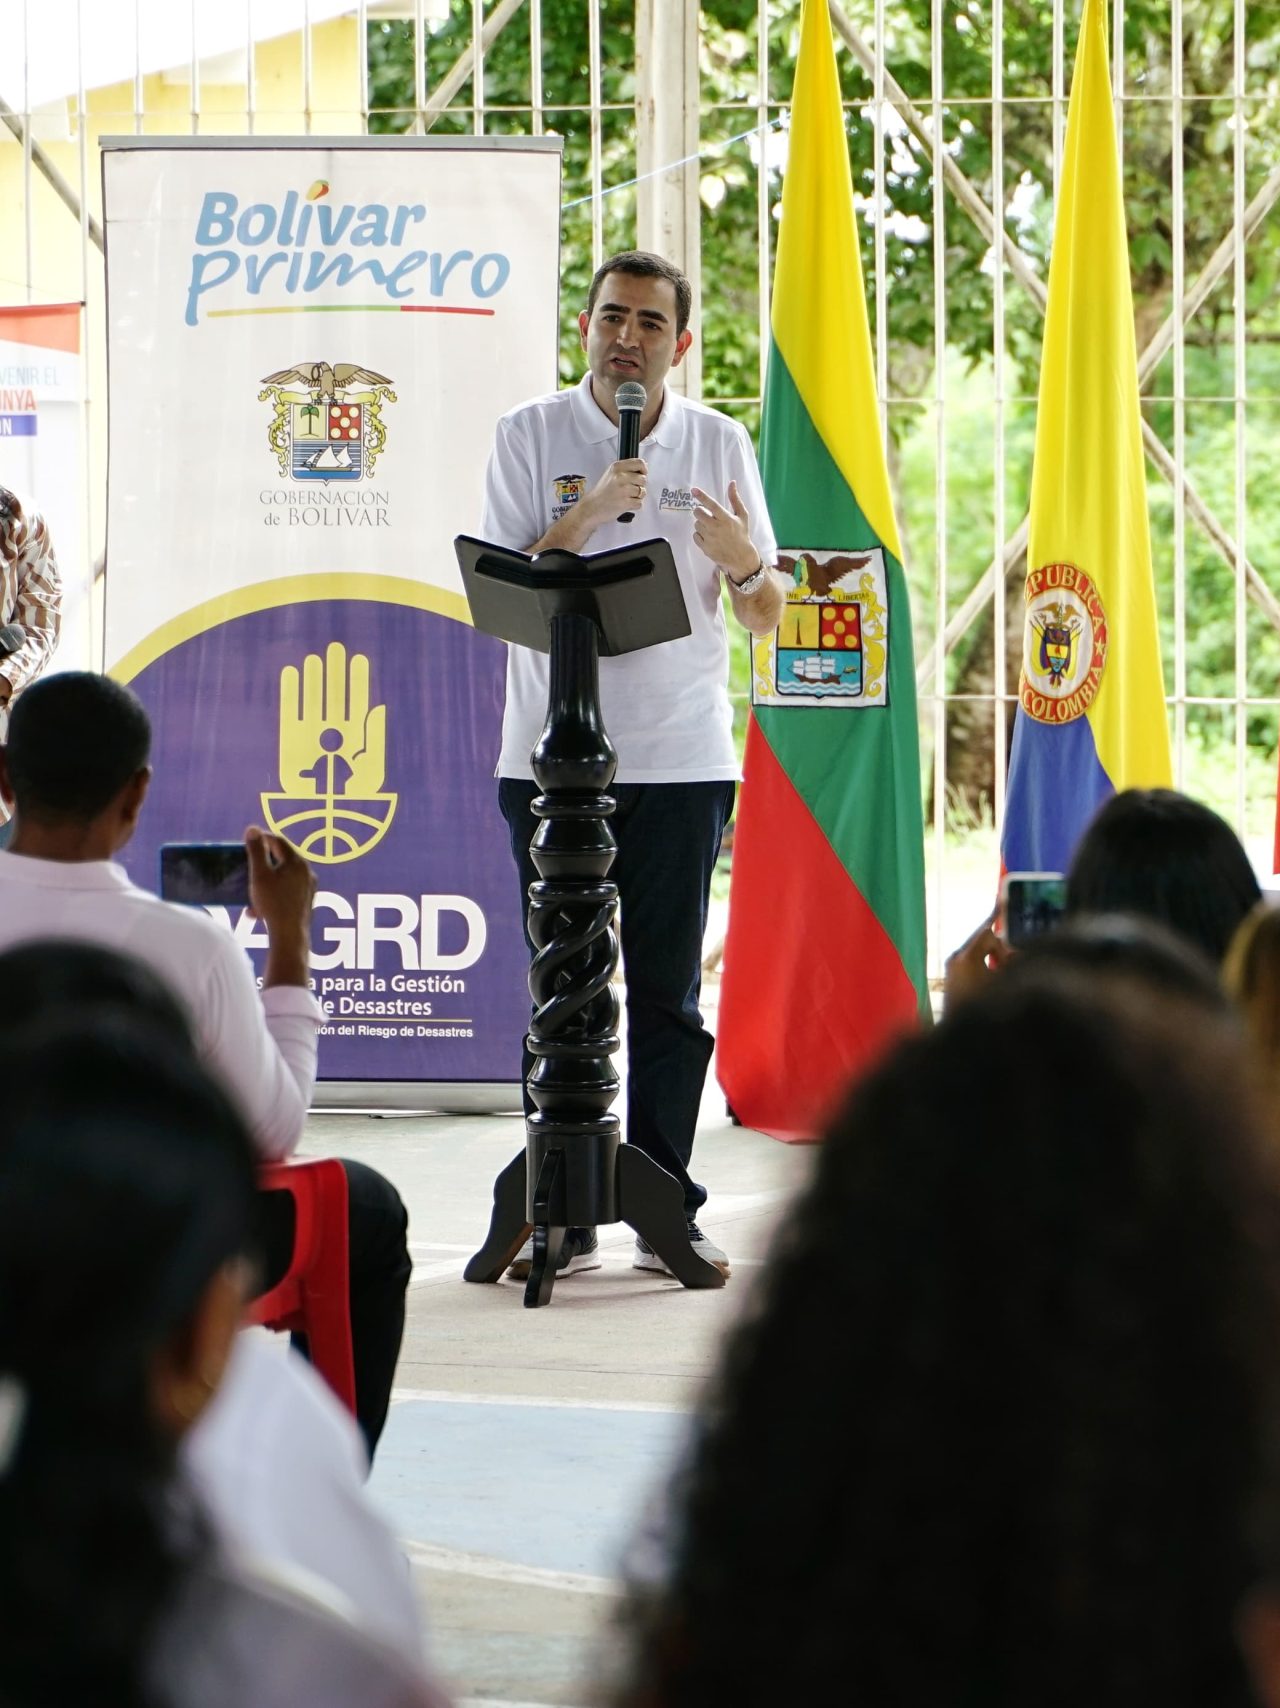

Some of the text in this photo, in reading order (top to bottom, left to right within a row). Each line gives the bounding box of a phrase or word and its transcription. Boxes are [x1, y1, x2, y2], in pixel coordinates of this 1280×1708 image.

[195, 180, 426, 247] Bolívar
[185, 250, 511, 327] primero
[44, 367, 60, 386] EL
[259, 488, 390, 506] GOBERNACIÓN
[264, 504, 392, 527] de BOLÍVAR
[1022, 666, 1101, 722] COLOMBIA
[321, 977, 364, 997] para
[369, 974, 386, 992] la
[390, 976, 466, 994] Gestión
[339, 997, 432, 1016] Desastres
[337, 1025, 355, 1035] del
[358, 1026, 397, 1039] Riesgo
[399, 1026, 414, 1037] de
[416, 1027, 473, 1038] Desastres
